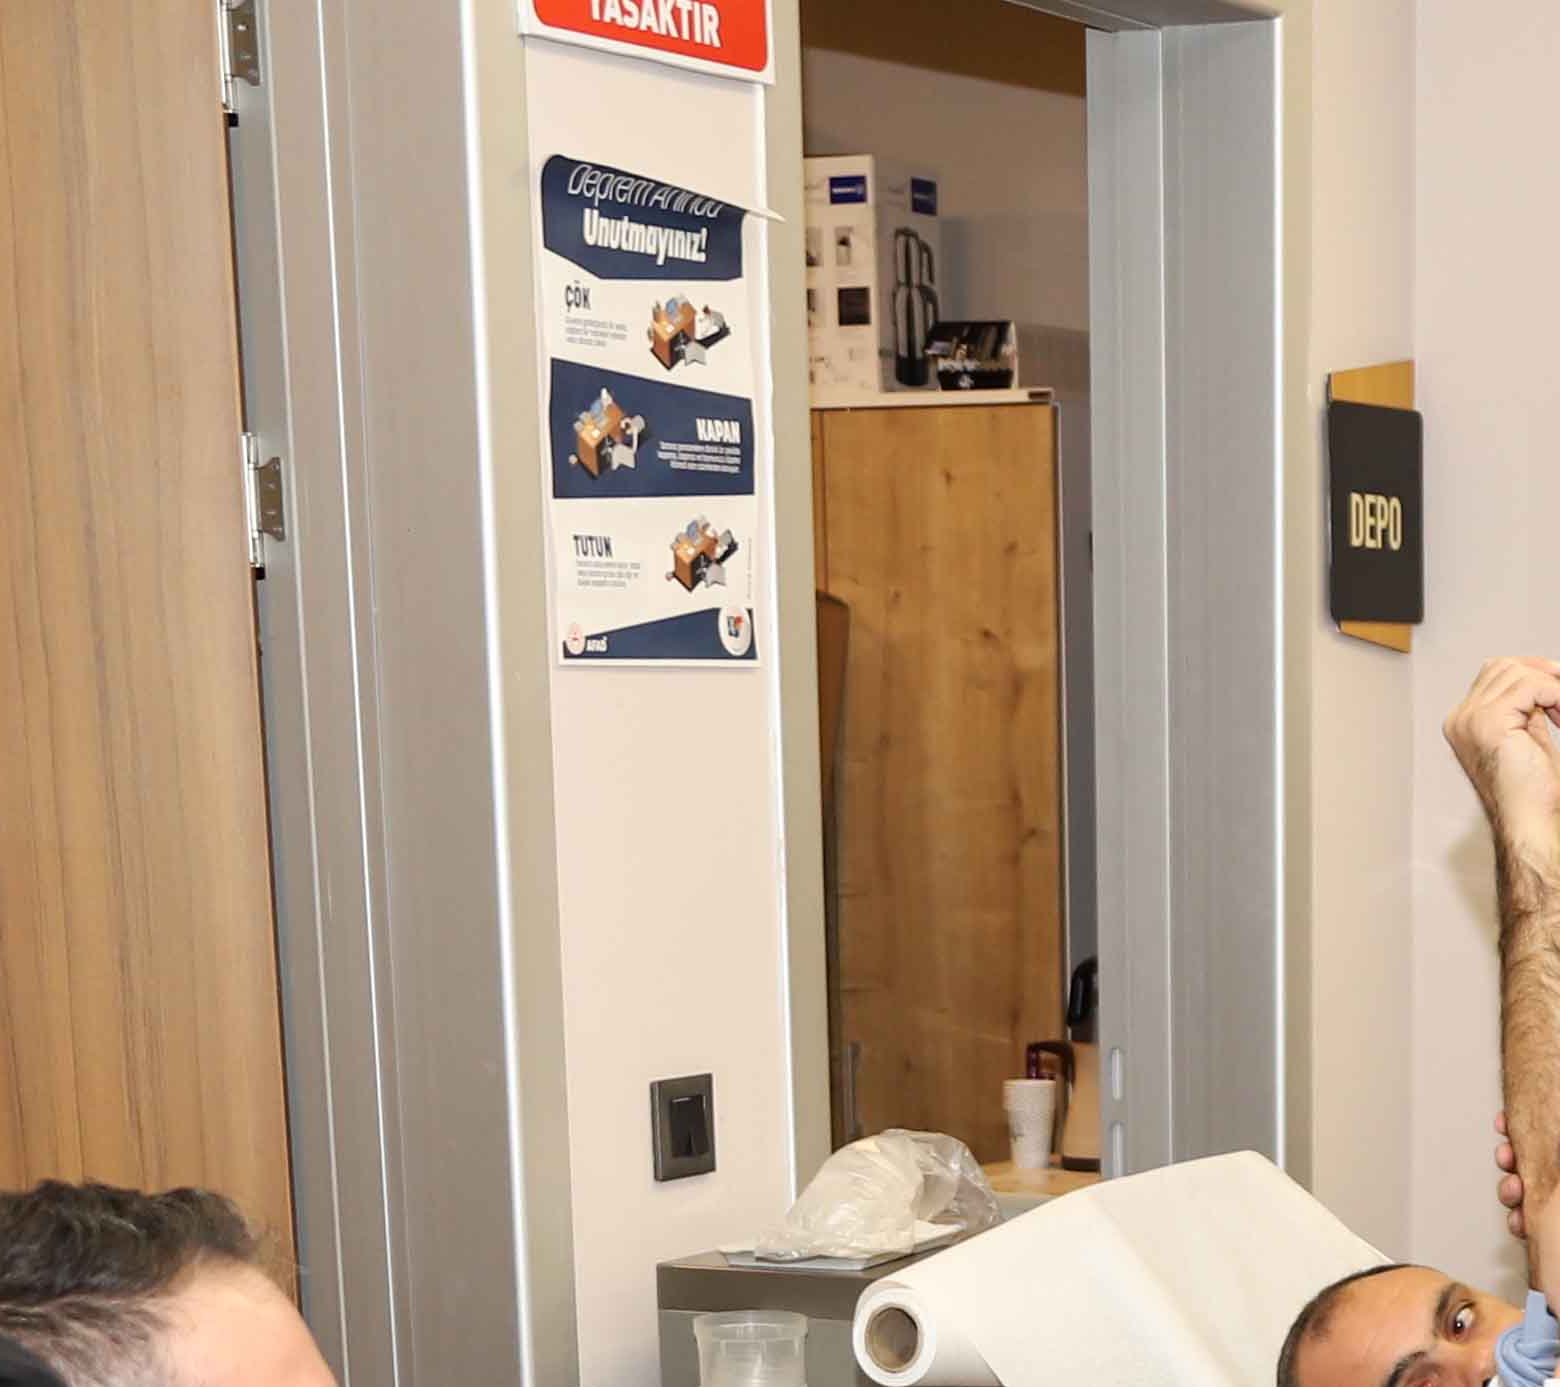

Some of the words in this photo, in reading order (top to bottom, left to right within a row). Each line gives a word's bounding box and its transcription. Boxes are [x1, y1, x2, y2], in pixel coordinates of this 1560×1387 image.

[568, 164, 652, 206] Deprem
[583, 208, 708, 265] Unutmayınız!
[565, 280, 591, 313] ÇÖK
[696, 417, 741, 443] KAPAN
[1350, 491, 1402, 550] DEPO
